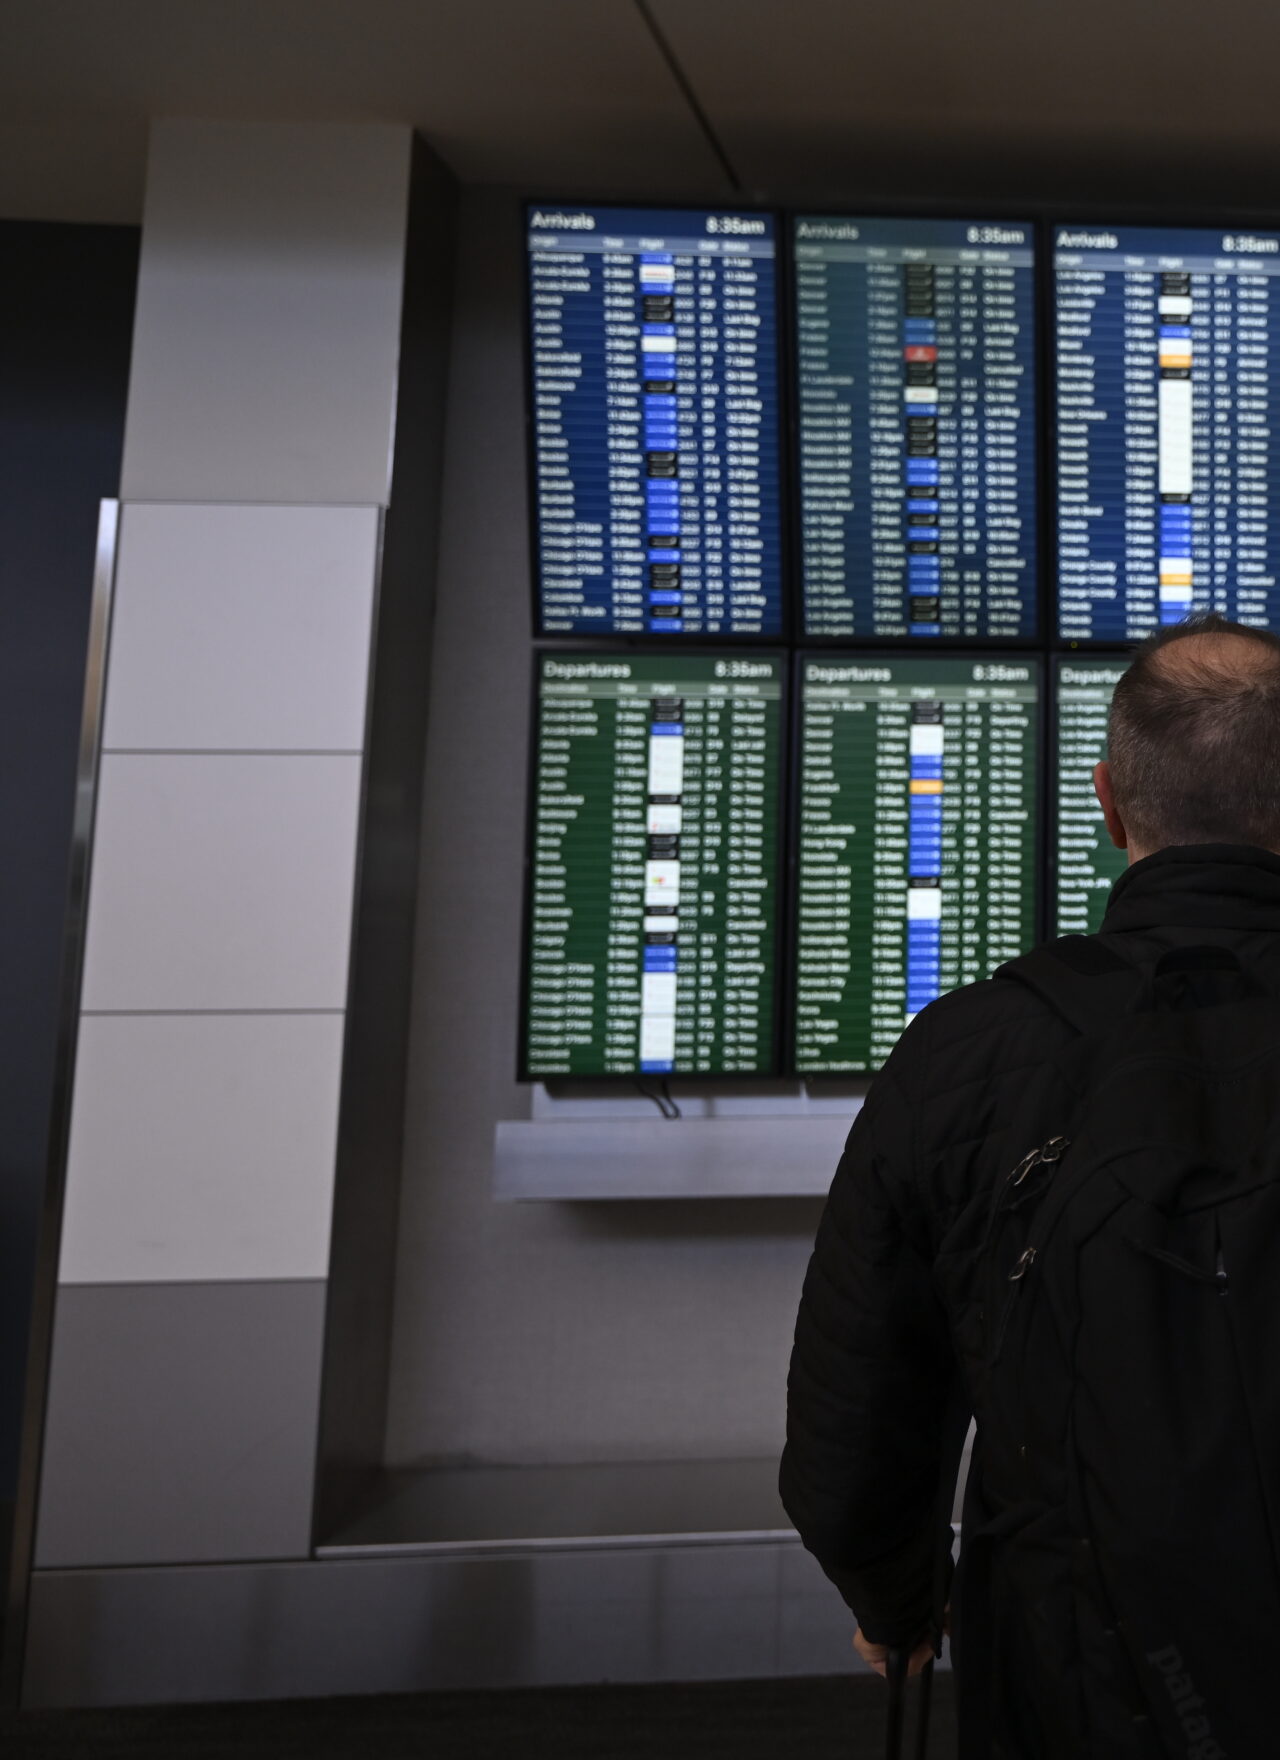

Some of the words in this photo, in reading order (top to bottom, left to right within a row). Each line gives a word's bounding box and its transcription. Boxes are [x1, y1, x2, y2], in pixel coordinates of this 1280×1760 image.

[531, 211, 595, 231] Arrivals
[706, 218, 765, 235] 8:35am
[798, 223, 858, 240] Arrivals
[967, 227, 1024, 244] 8:35am
[1057, 231, 1118, 249] Arrivals
[1223, 236, 1278, 253] 8:35am
[543, 661, 631, 679] Departures
[715, 662, 772, 678] 8:35am
[806, 665, 891, 682] Departures
[973, 666, 1028, 682] 8:35am
